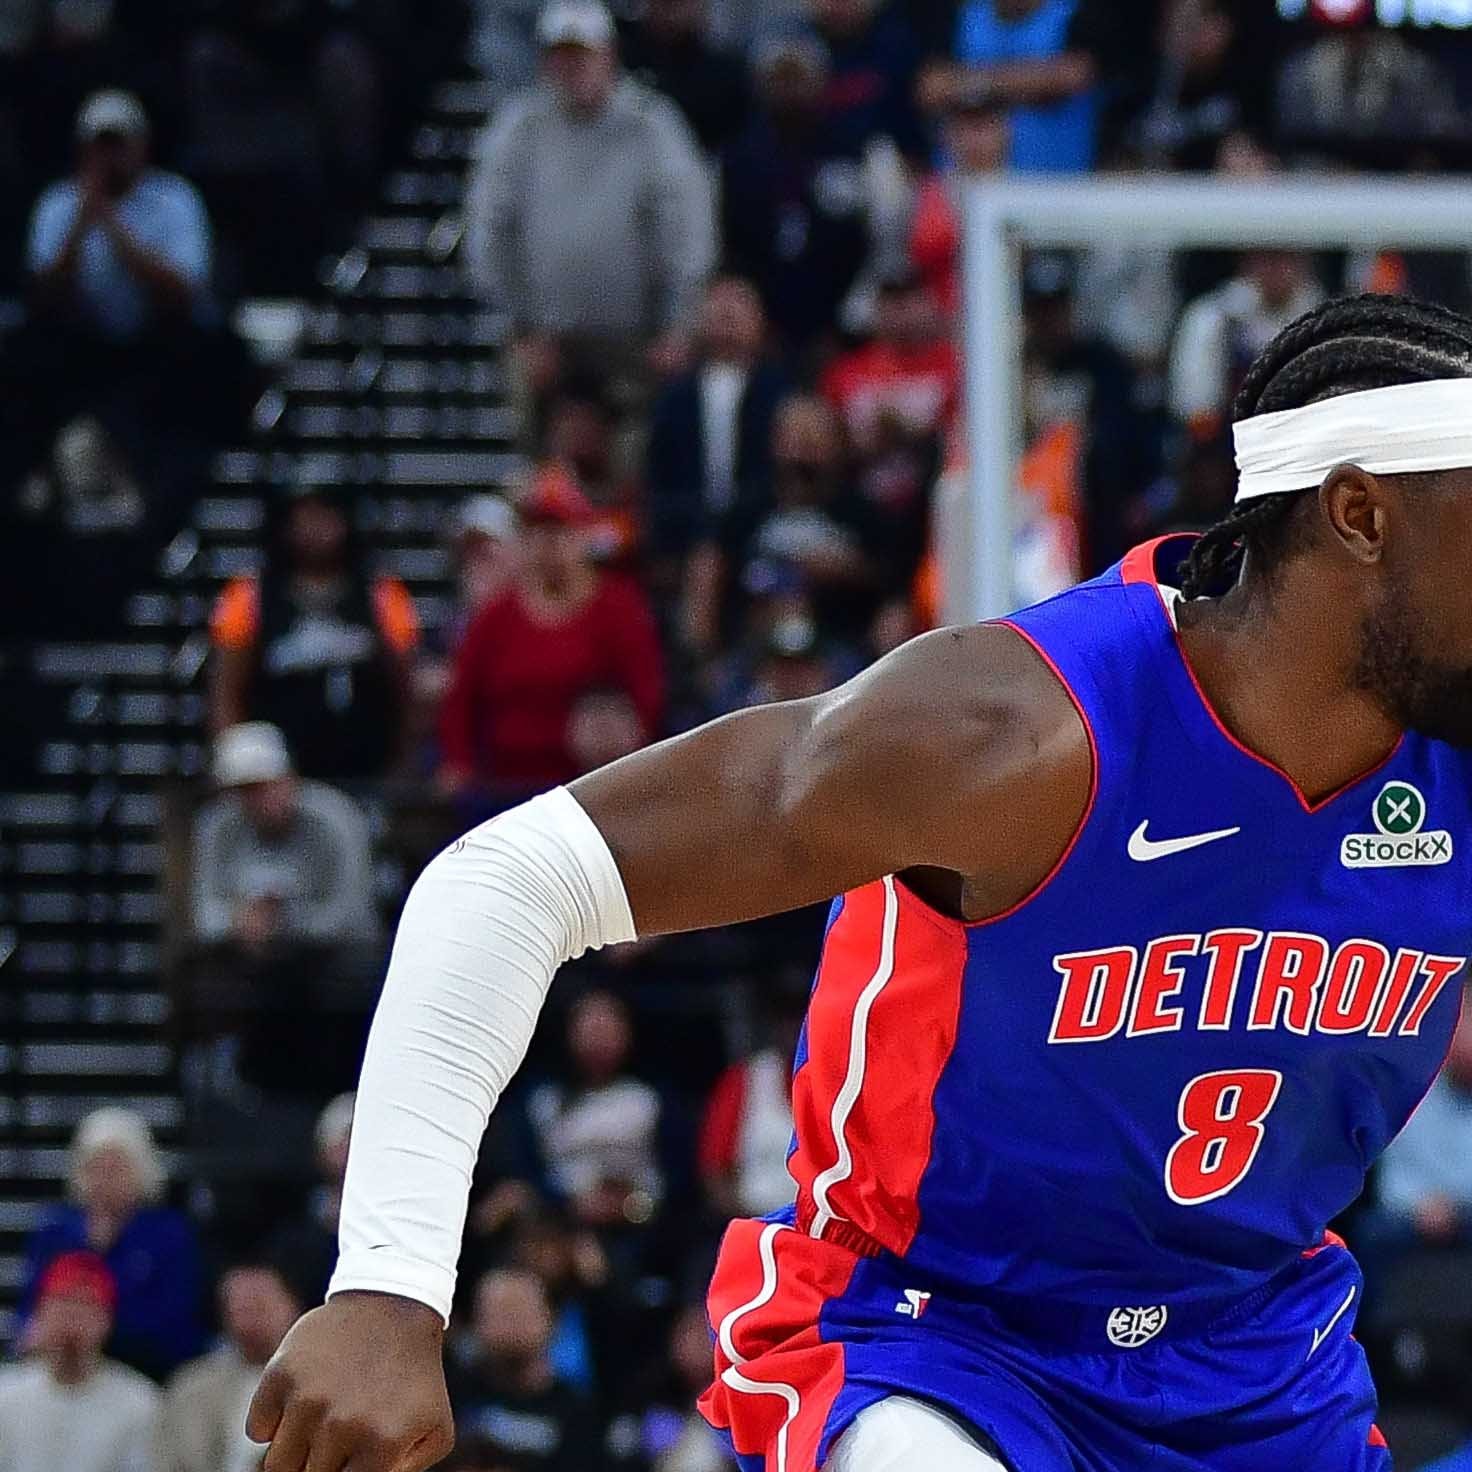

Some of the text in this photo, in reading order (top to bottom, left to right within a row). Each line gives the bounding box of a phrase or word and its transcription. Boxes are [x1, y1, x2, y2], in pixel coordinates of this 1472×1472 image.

[1345, 834, 1449, 861] StockX
[1047, 928, 1467, 1044] DETROIT
[1164, 1069, 1283, 1206] 8
